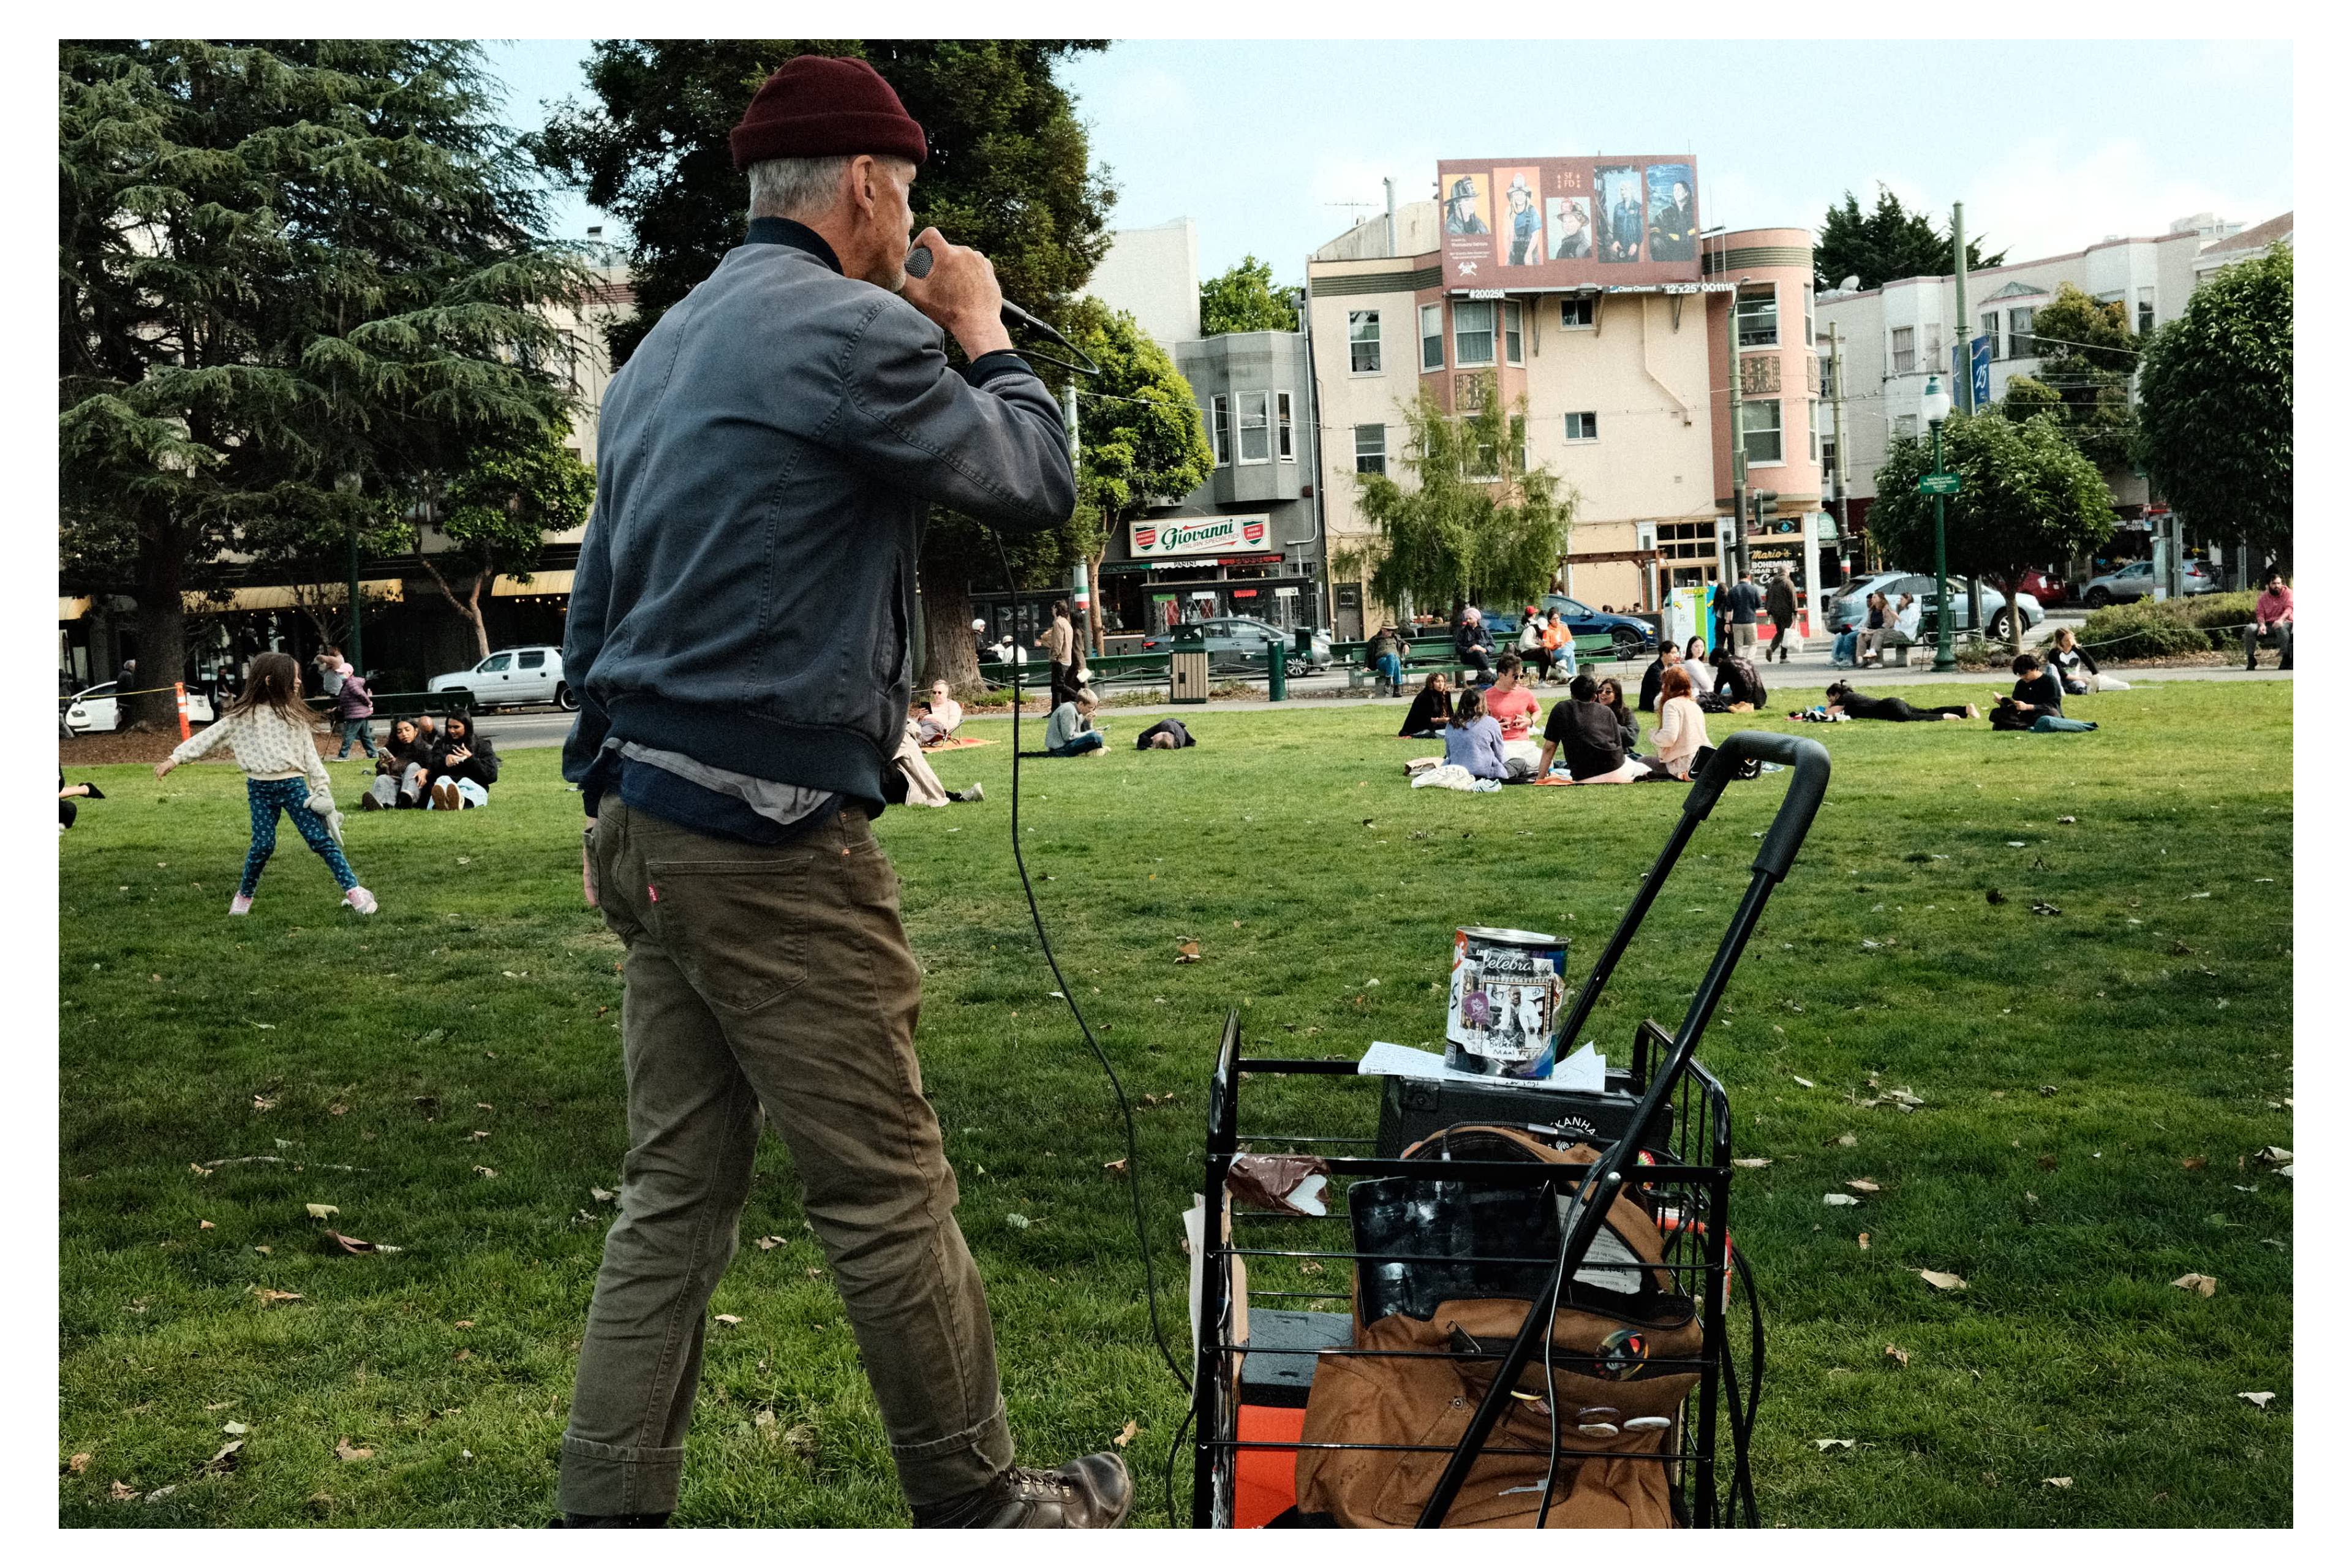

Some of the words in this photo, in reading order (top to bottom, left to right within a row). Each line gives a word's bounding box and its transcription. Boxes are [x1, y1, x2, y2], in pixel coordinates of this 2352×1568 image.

[1701, 283, 1736, 292] 001115
[1469, 289, 1505, 298] #200256
[1976, 364, 1987, 389] 25
[1161, 519, 1233, 550] Giovanni
[1204, 533, 1240, 546] SPECIALTIES
[1747, 548, 1792, 559] Mario's
[1752, 560, 1794, 569] BOHEMIAN
[1550, 1117, 1596, 1135] KANHA
[1608, 1267, 1627, 1276] Track
